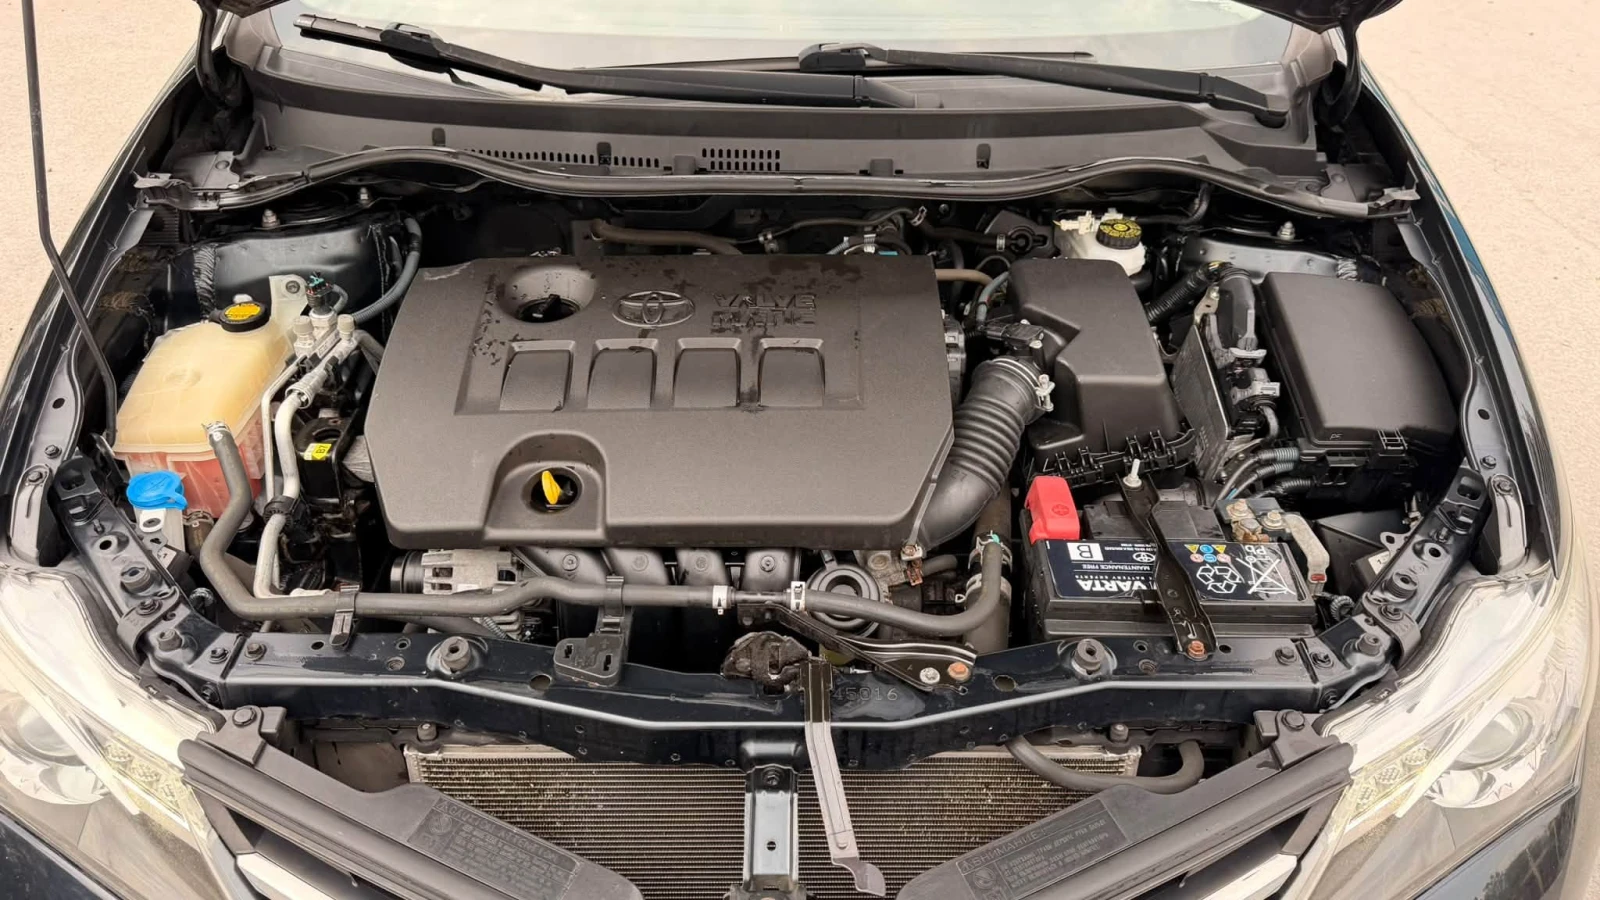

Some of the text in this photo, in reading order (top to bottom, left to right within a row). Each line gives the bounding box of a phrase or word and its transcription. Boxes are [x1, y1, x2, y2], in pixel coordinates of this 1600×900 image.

[1077, 545, 1093, 559] B
[1245, 545, 1266, 554] Pb
[1077, 580, 1147, 591] VARTA
[834, 687, 898, 700] 45016
